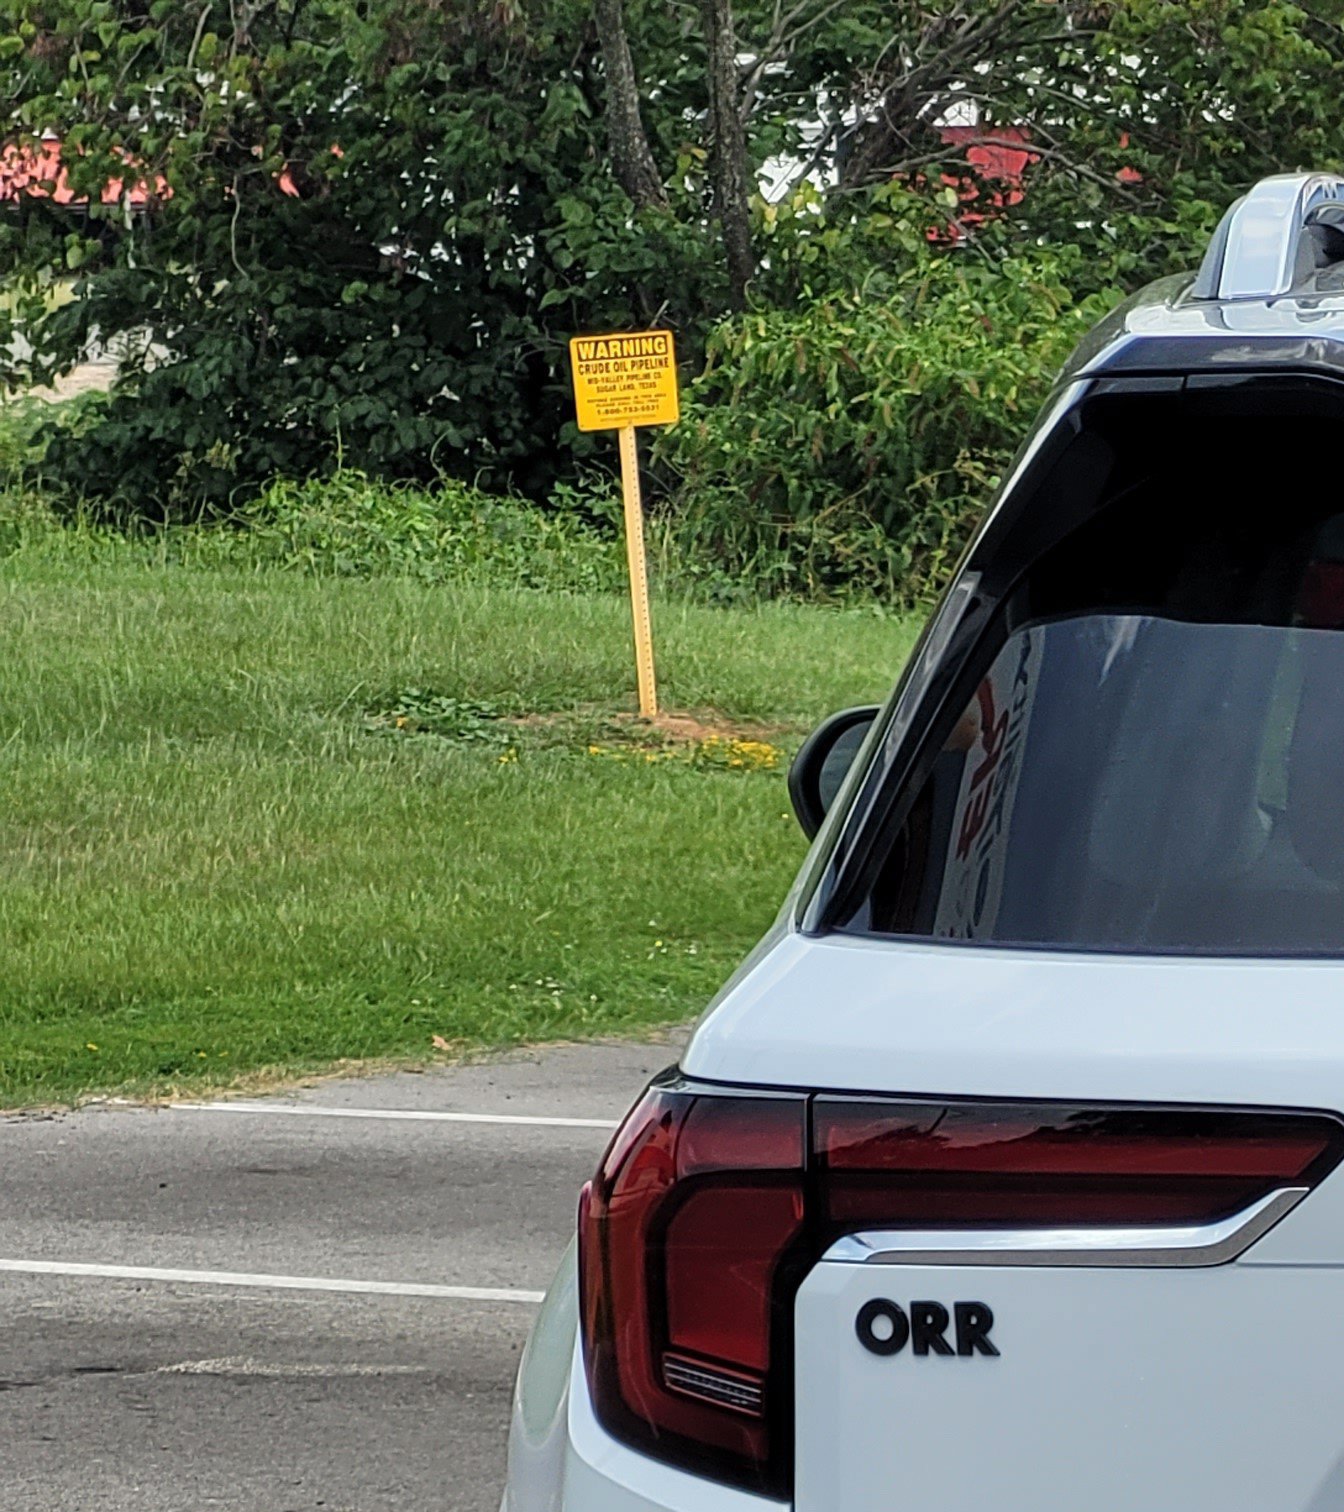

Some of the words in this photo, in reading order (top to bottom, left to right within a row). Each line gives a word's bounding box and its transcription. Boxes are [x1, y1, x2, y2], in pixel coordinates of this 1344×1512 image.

[579, 337, 666, 360] WARNING
[578, 362, 610, 375] CRUDE
[614, 361, 628, 373] OIL
[631, 357, 668, 370] PIPELINE
[855, 1297, 1001, 1357] ORR
